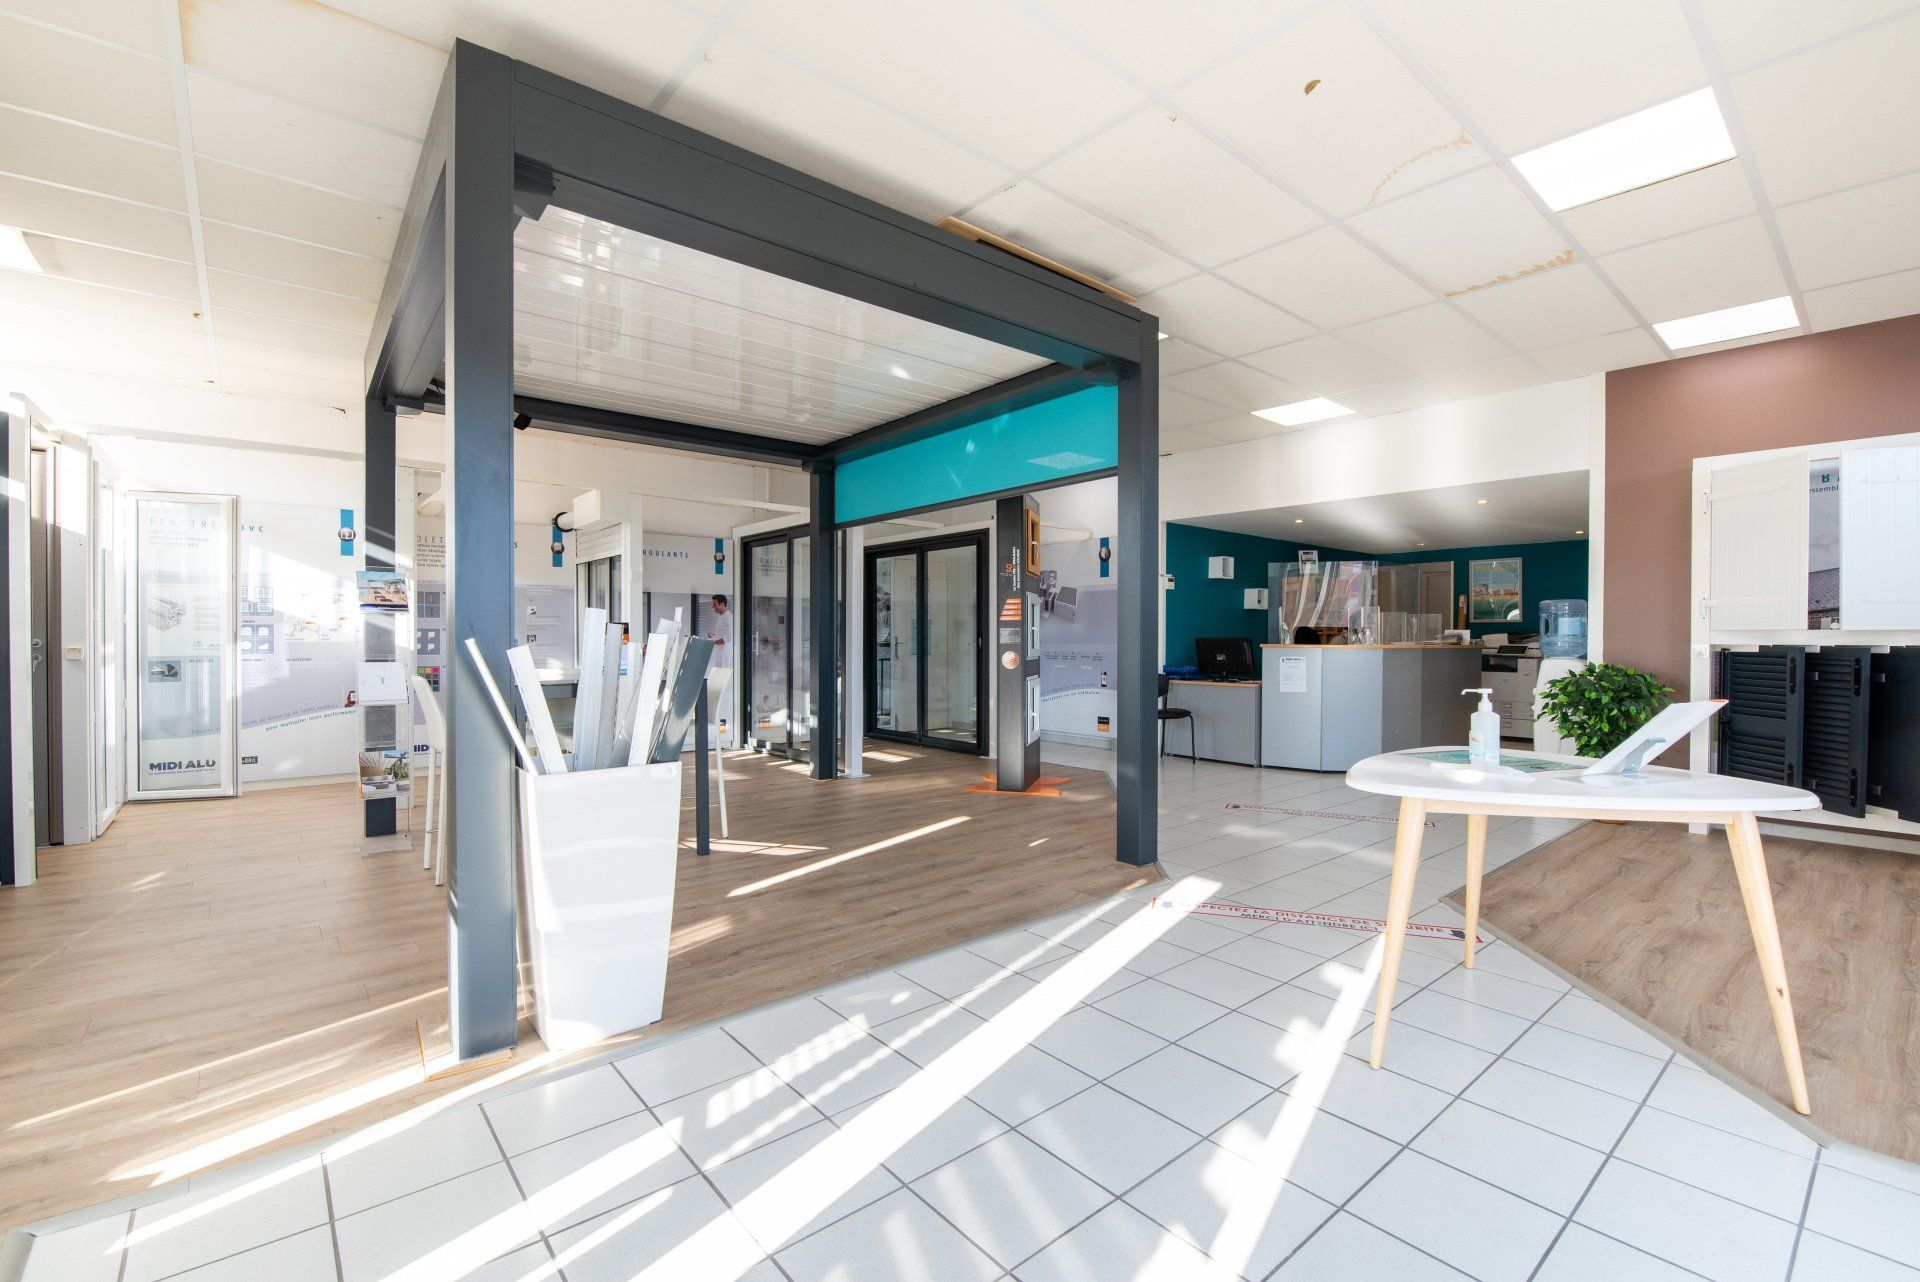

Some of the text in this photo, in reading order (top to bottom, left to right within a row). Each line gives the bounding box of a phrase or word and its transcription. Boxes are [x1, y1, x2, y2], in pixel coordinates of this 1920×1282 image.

[416, 535, 444, 543] OLET
[642, 549, 689, 559] ROULANTS
[149, 760, 183, 772] MIDI
[185, 758, 217, 770] ALU
[1240, 912, 1279, 921] MERCI
[1275, 911, 1346, 923] DISTANCE
